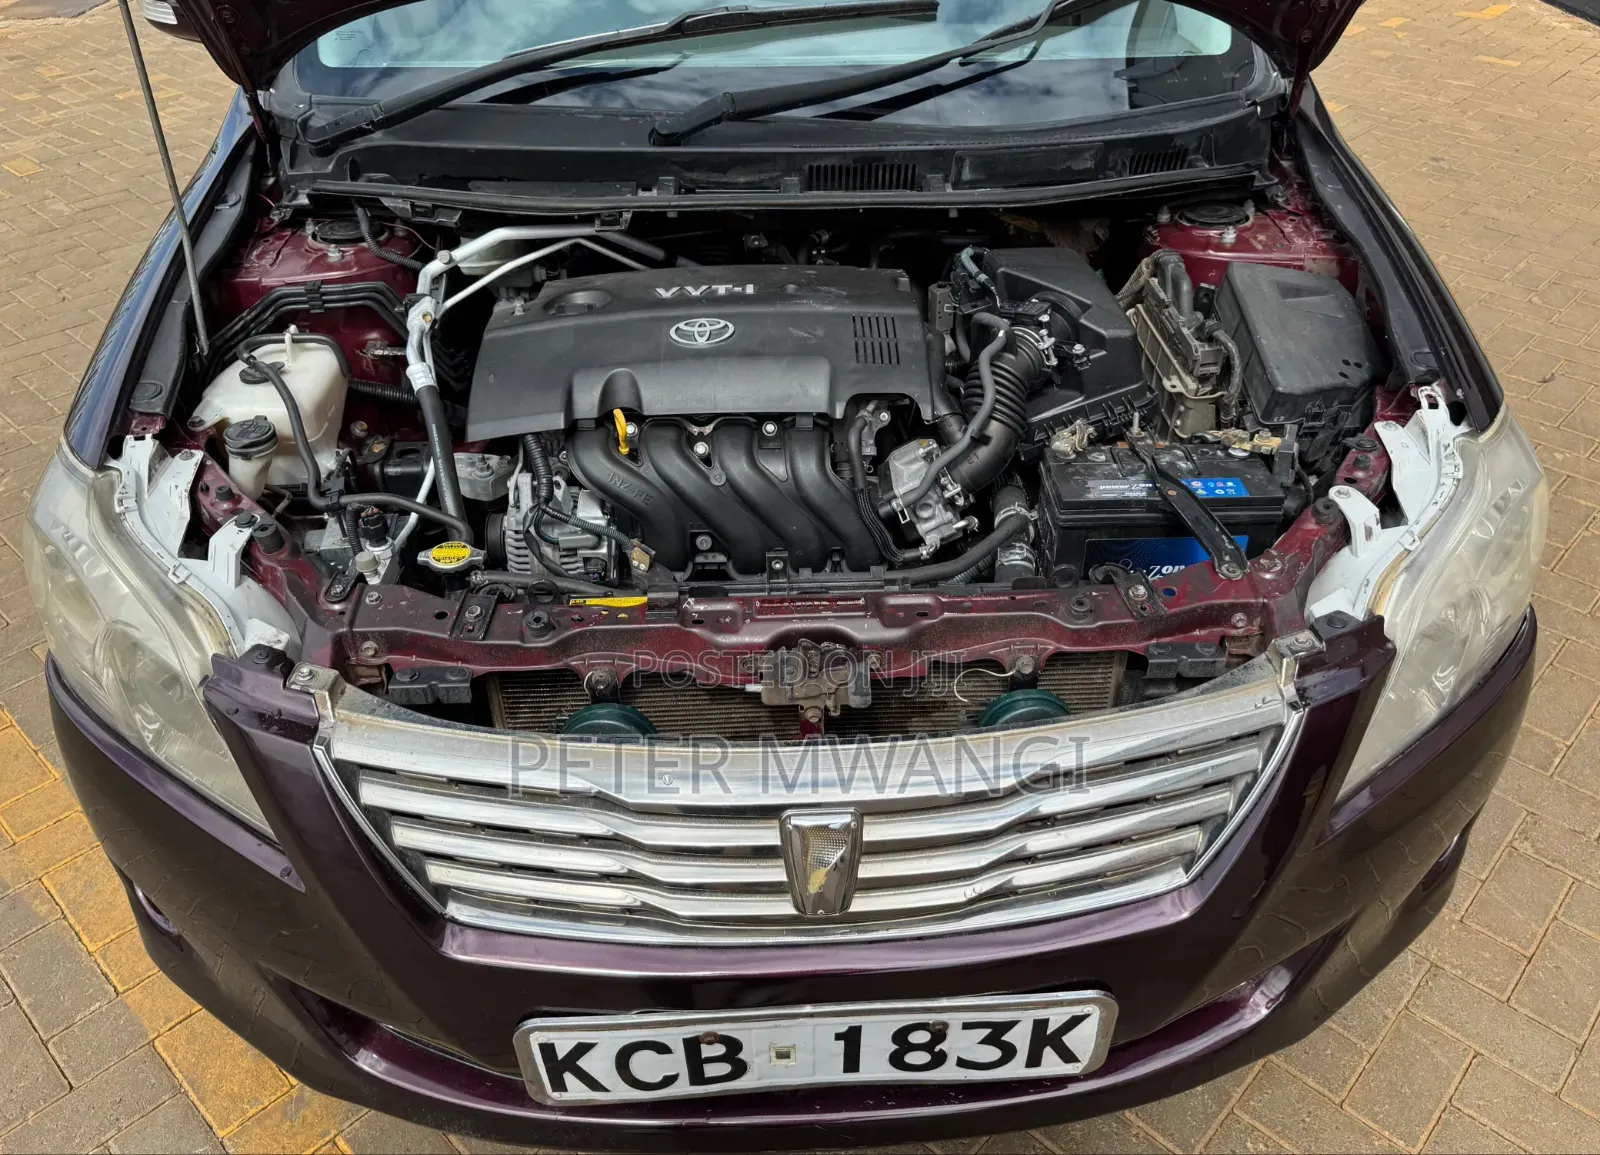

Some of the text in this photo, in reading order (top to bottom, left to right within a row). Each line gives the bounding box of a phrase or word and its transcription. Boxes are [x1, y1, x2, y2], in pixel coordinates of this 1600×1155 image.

[1148, 564, 1186, 581] Zon
[538, 1013, 1093, 1093] KCB 183K
